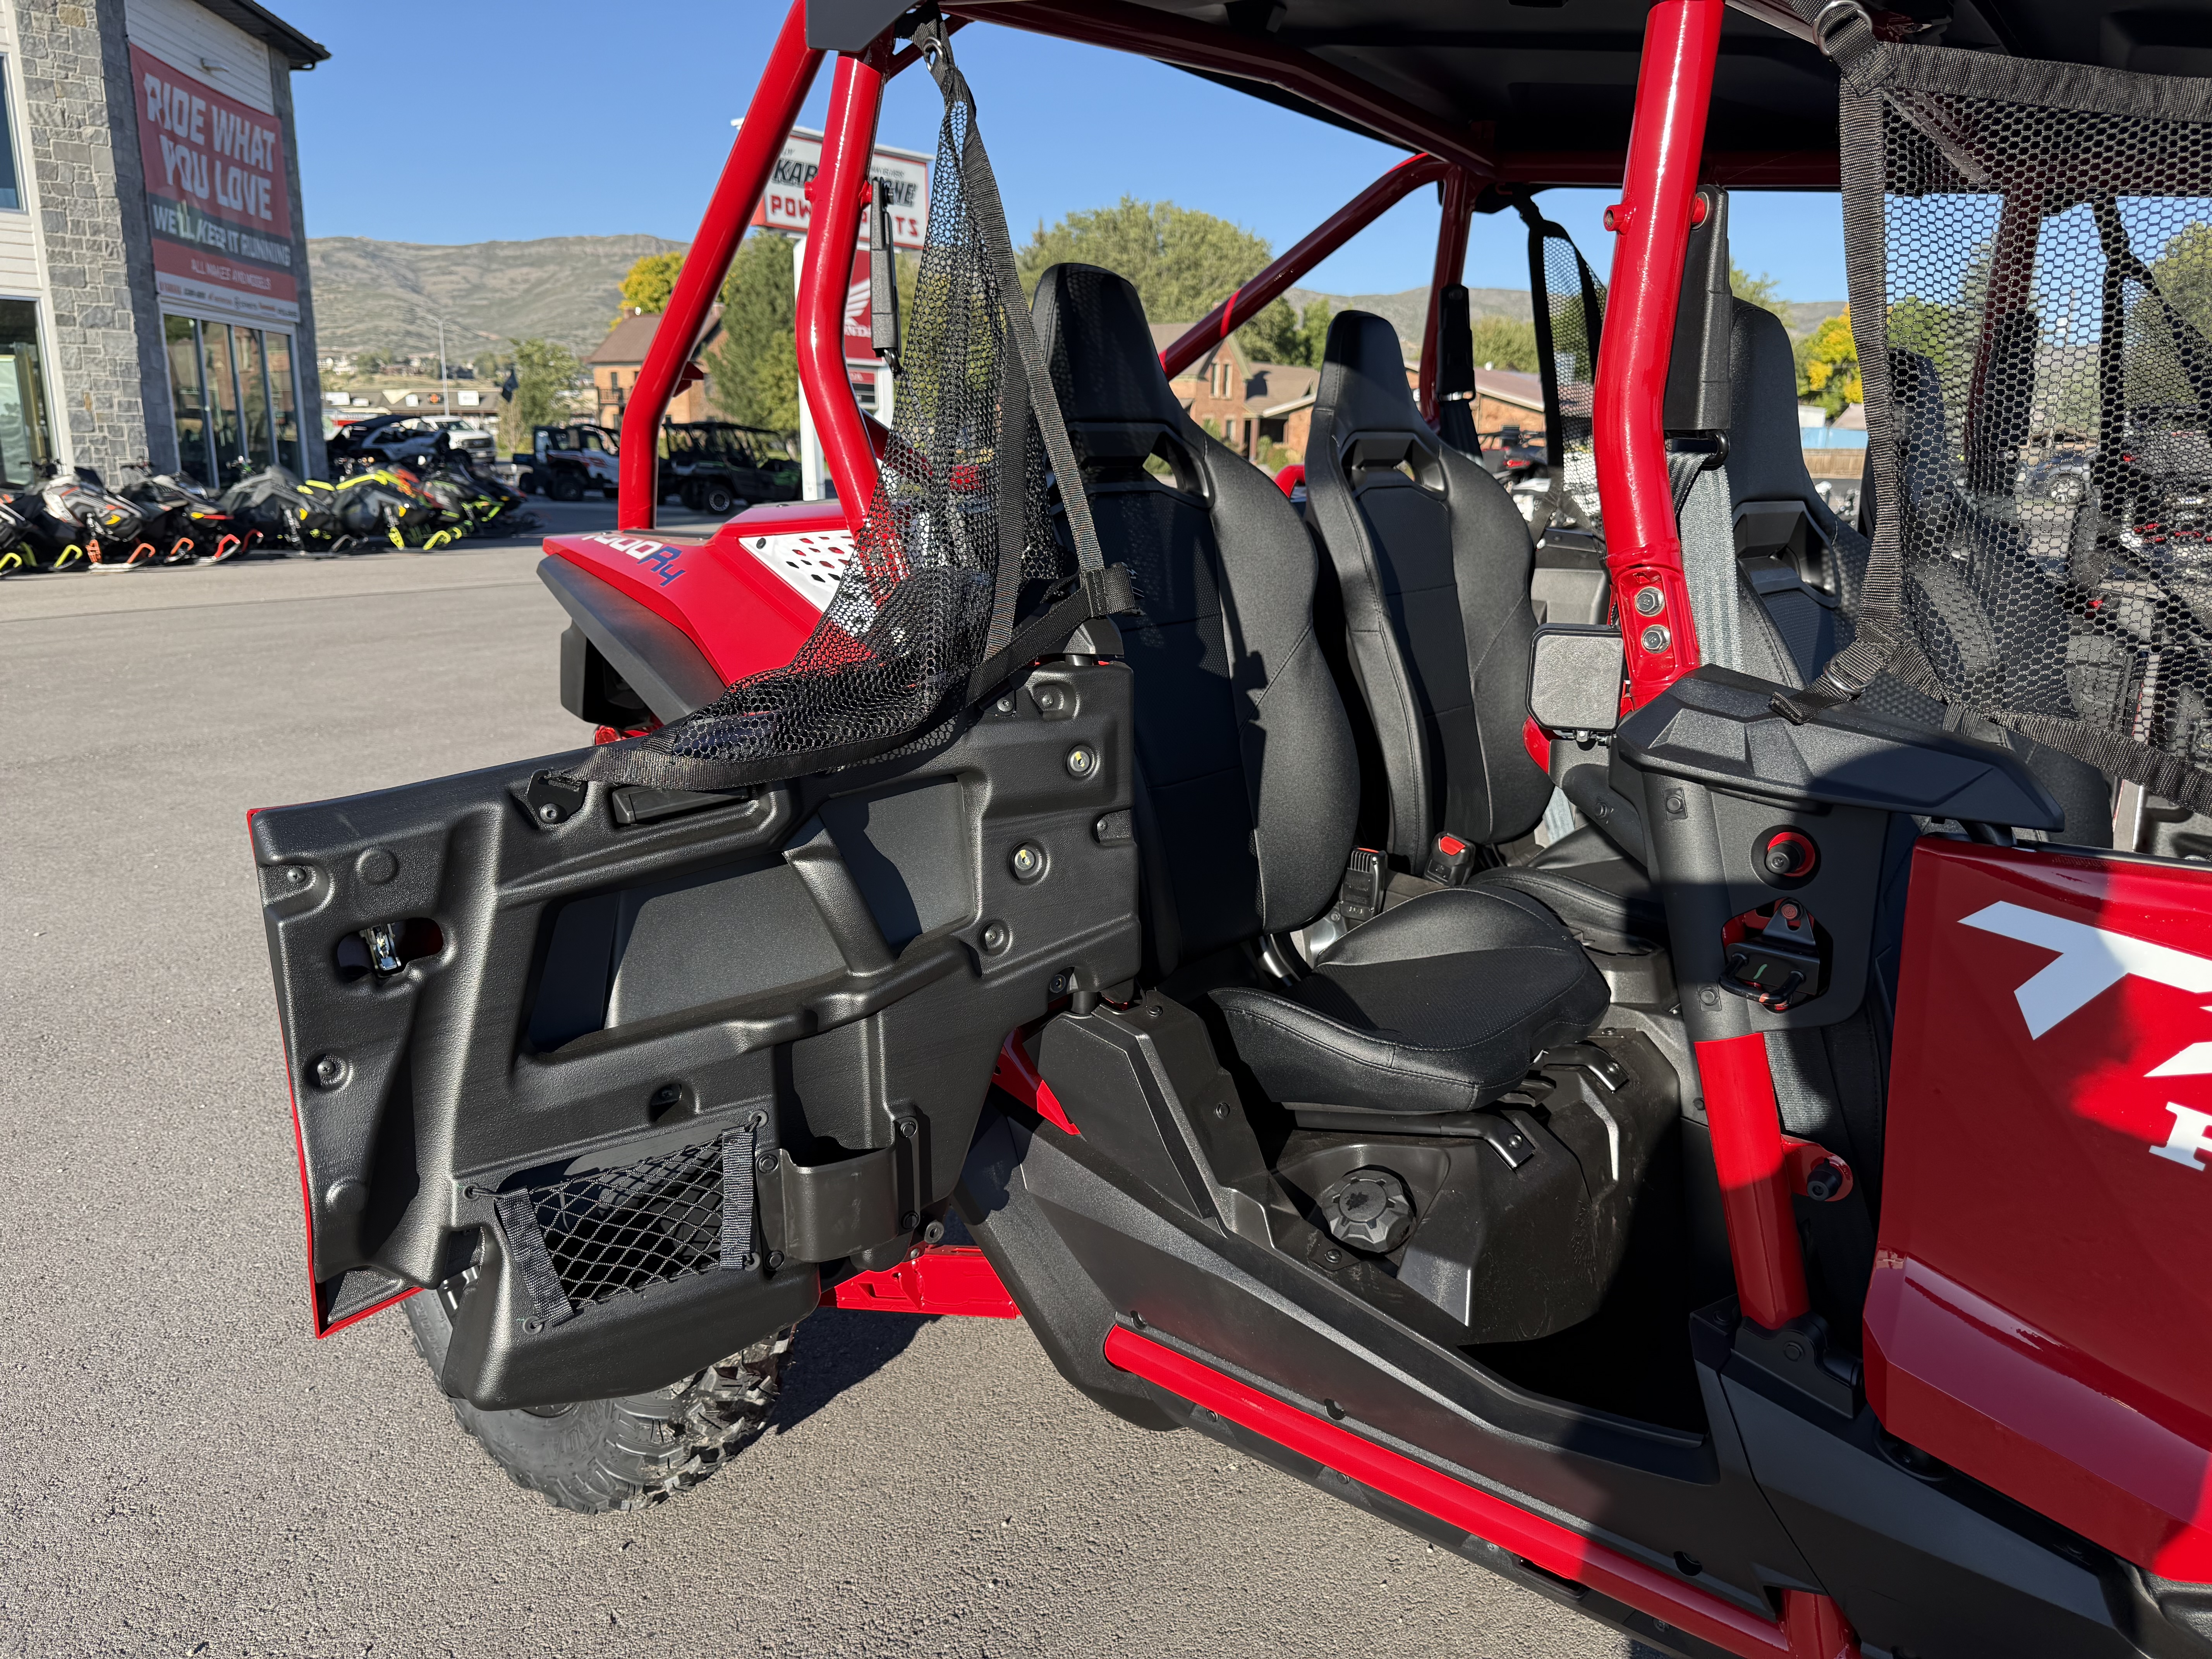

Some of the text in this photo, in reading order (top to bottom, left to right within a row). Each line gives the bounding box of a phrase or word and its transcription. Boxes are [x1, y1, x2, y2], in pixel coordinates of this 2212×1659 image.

[144, 73, 276, 172] RIDE WHAT
[160, 135, 272, 221] YOU LOVE
[227, 229, 239, 254] IT
